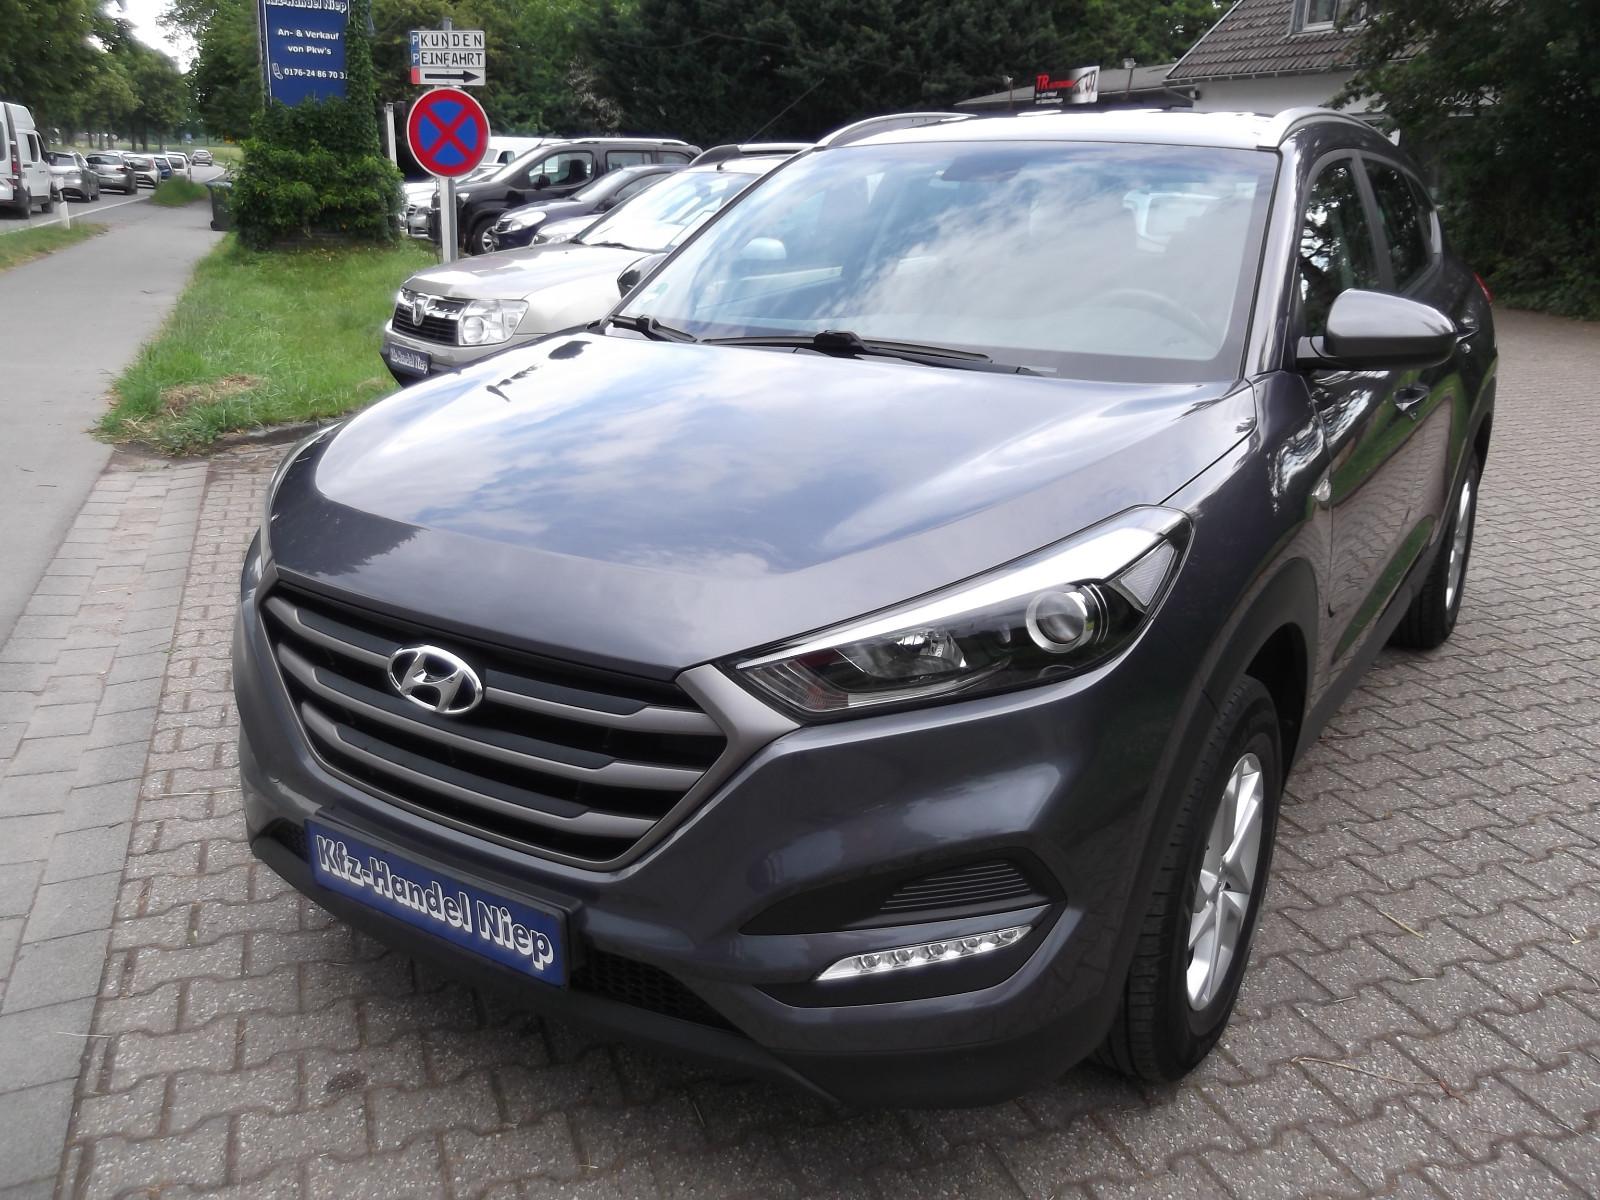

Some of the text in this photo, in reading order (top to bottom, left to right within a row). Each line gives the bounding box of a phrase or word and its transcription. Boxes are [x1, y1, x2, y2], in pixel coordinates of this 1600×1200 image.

[277, 28, 339, 40] An- & Verkauf
[412, 33, 482, 47] P KUNDEN
[306, 46, 332, 55] Pkw's
[413, 52, 482, 65] P EINFAHRT
[284, 68, 315, 77] 0176-24
[317, 70, 327, 78] 86
[329, 71, 338, 79] 70
[316, 834, 554, 970] Kfz-Handel Niep
